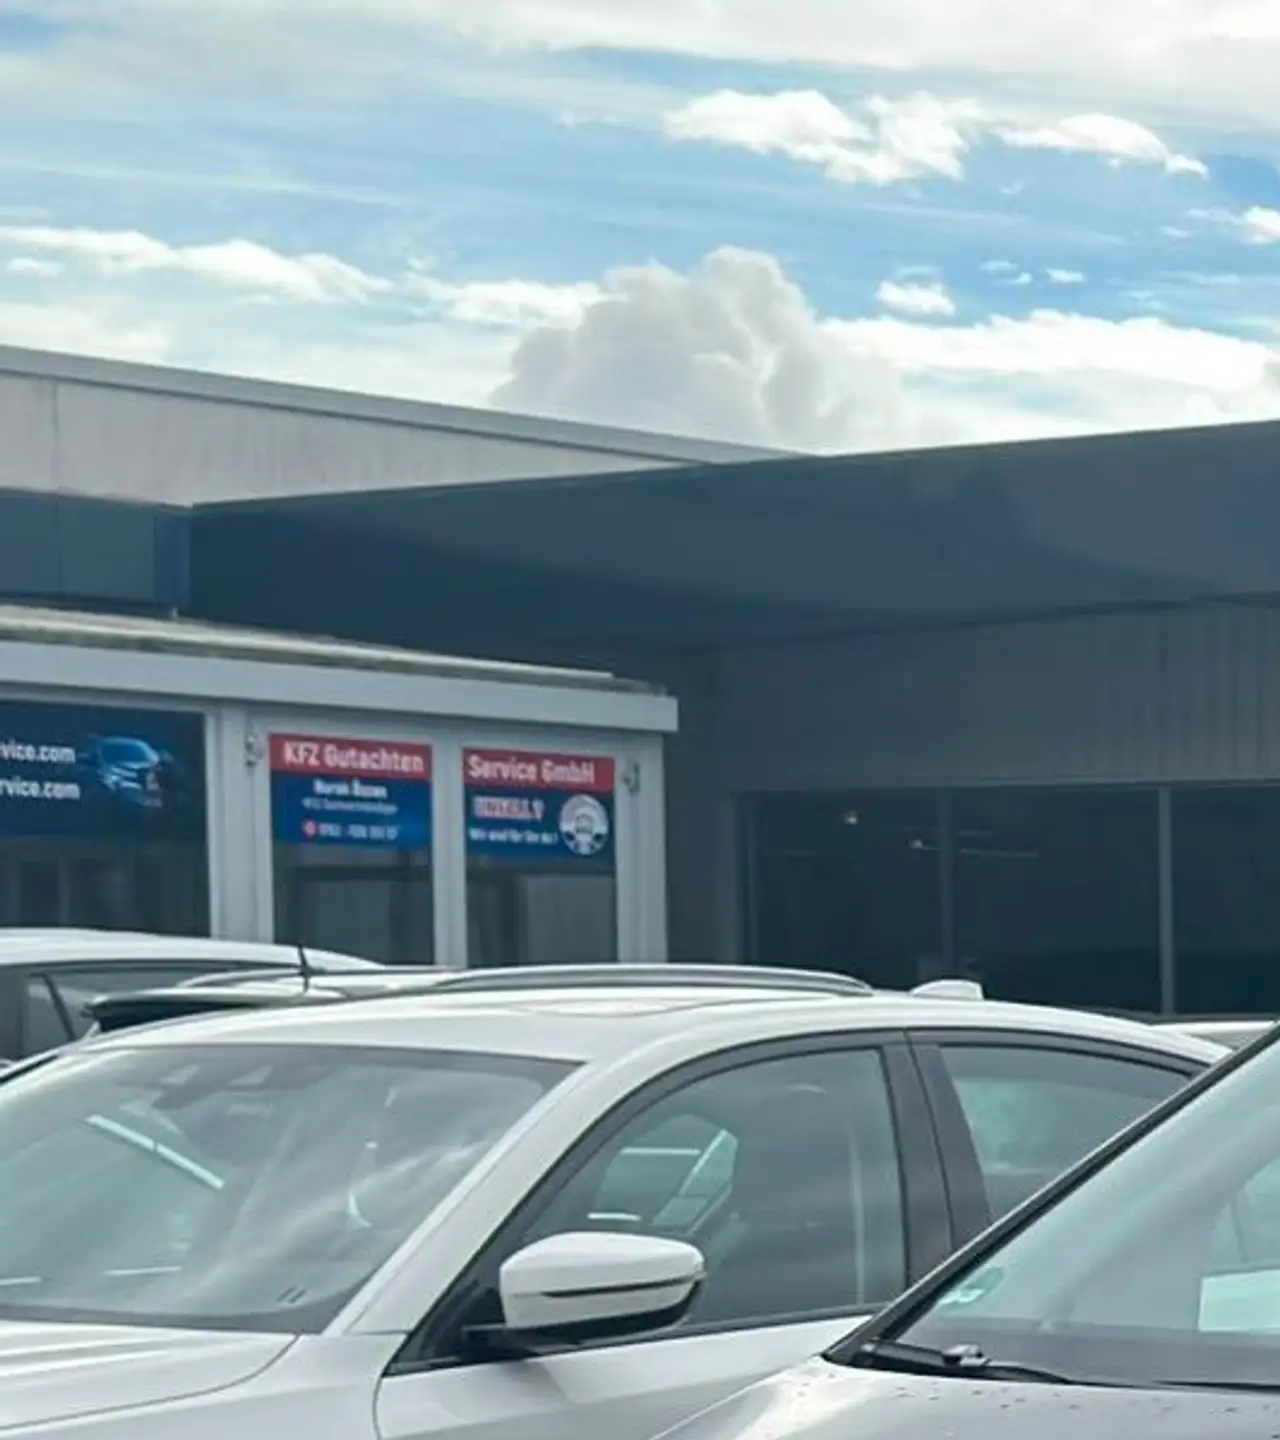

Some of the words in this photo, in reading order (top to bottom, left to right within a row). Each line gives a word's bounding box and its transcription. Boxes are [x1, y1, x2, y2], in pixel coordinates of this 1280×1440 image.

[0, 739, 76, 764] vice.com
[284, 741, 321, 767] KFZ
[324, 743, 424, 773] Gutachten
[468, 754, 538, 782] Service
[541, 759, 596, 785] GmbH
